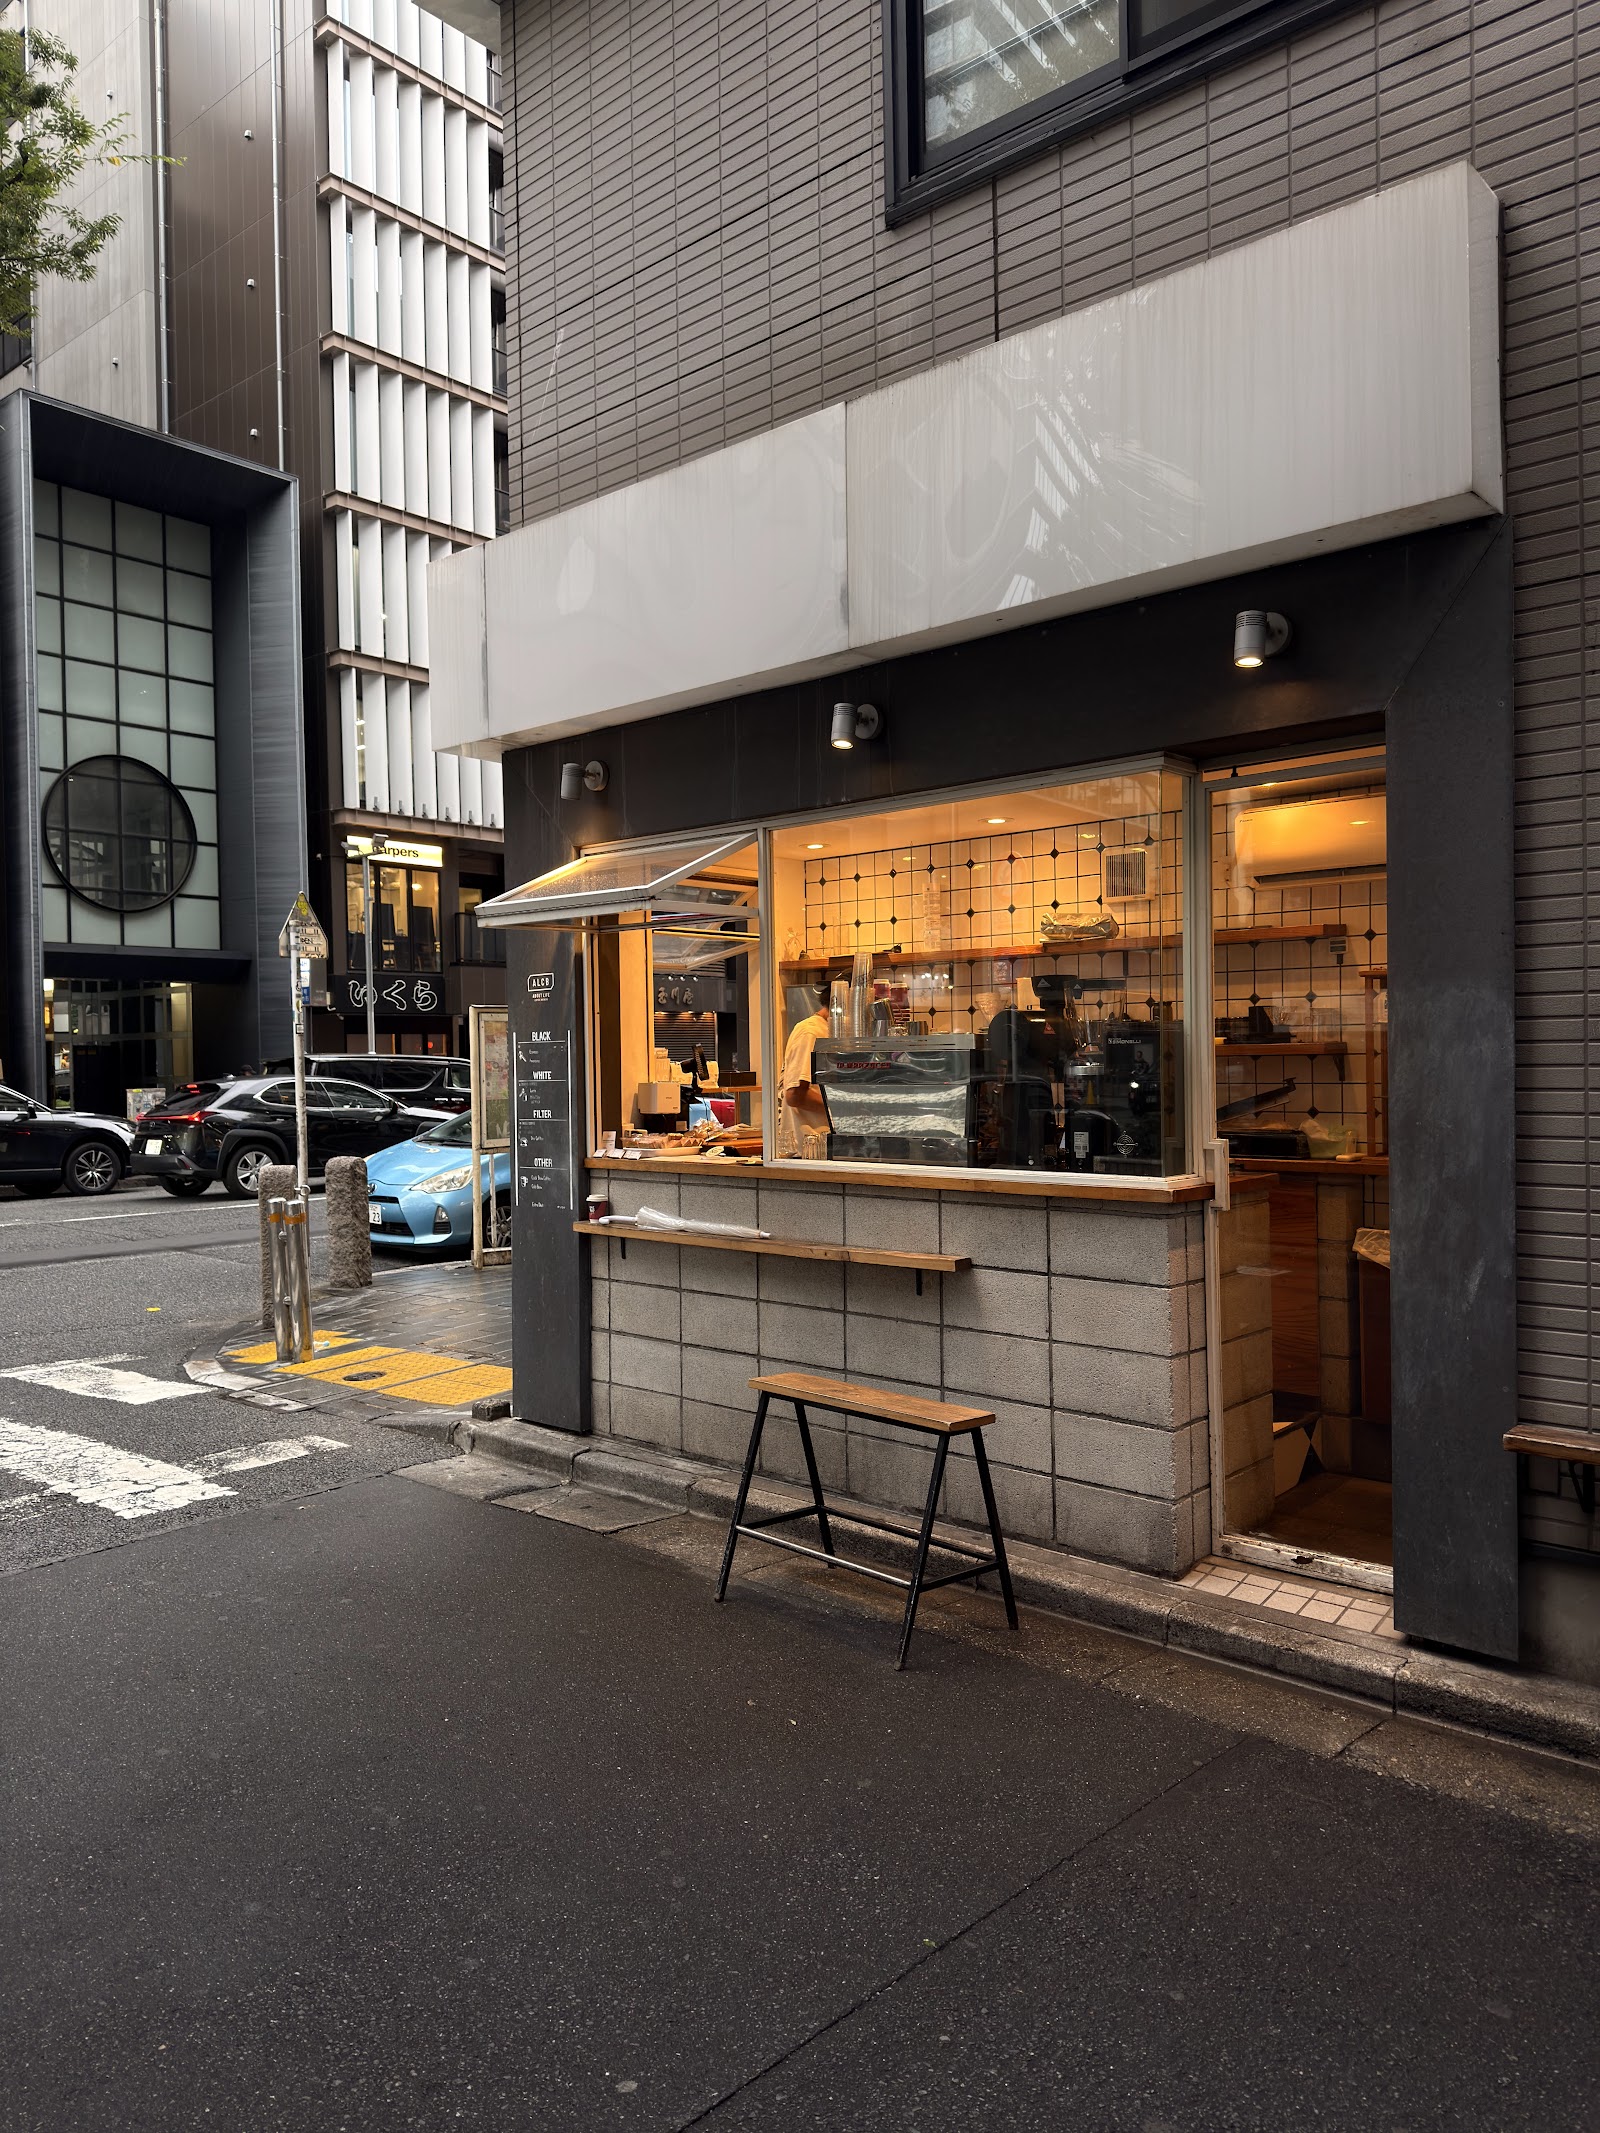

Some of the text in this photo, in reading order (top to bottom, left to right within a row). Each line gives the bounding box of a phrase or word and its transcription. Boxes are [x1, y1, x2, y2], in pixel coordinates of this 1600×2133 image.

[532, 977, 550, 988] ALCB
[348, 979, 438, 1012] いくら
[531, 1030, 552, 1042] BLACK
[532, 1070, 552, 1080] WHITE
[533, 1109, 552, 1119] FILTER
[533, 1157, 553, 1168] OTHER
